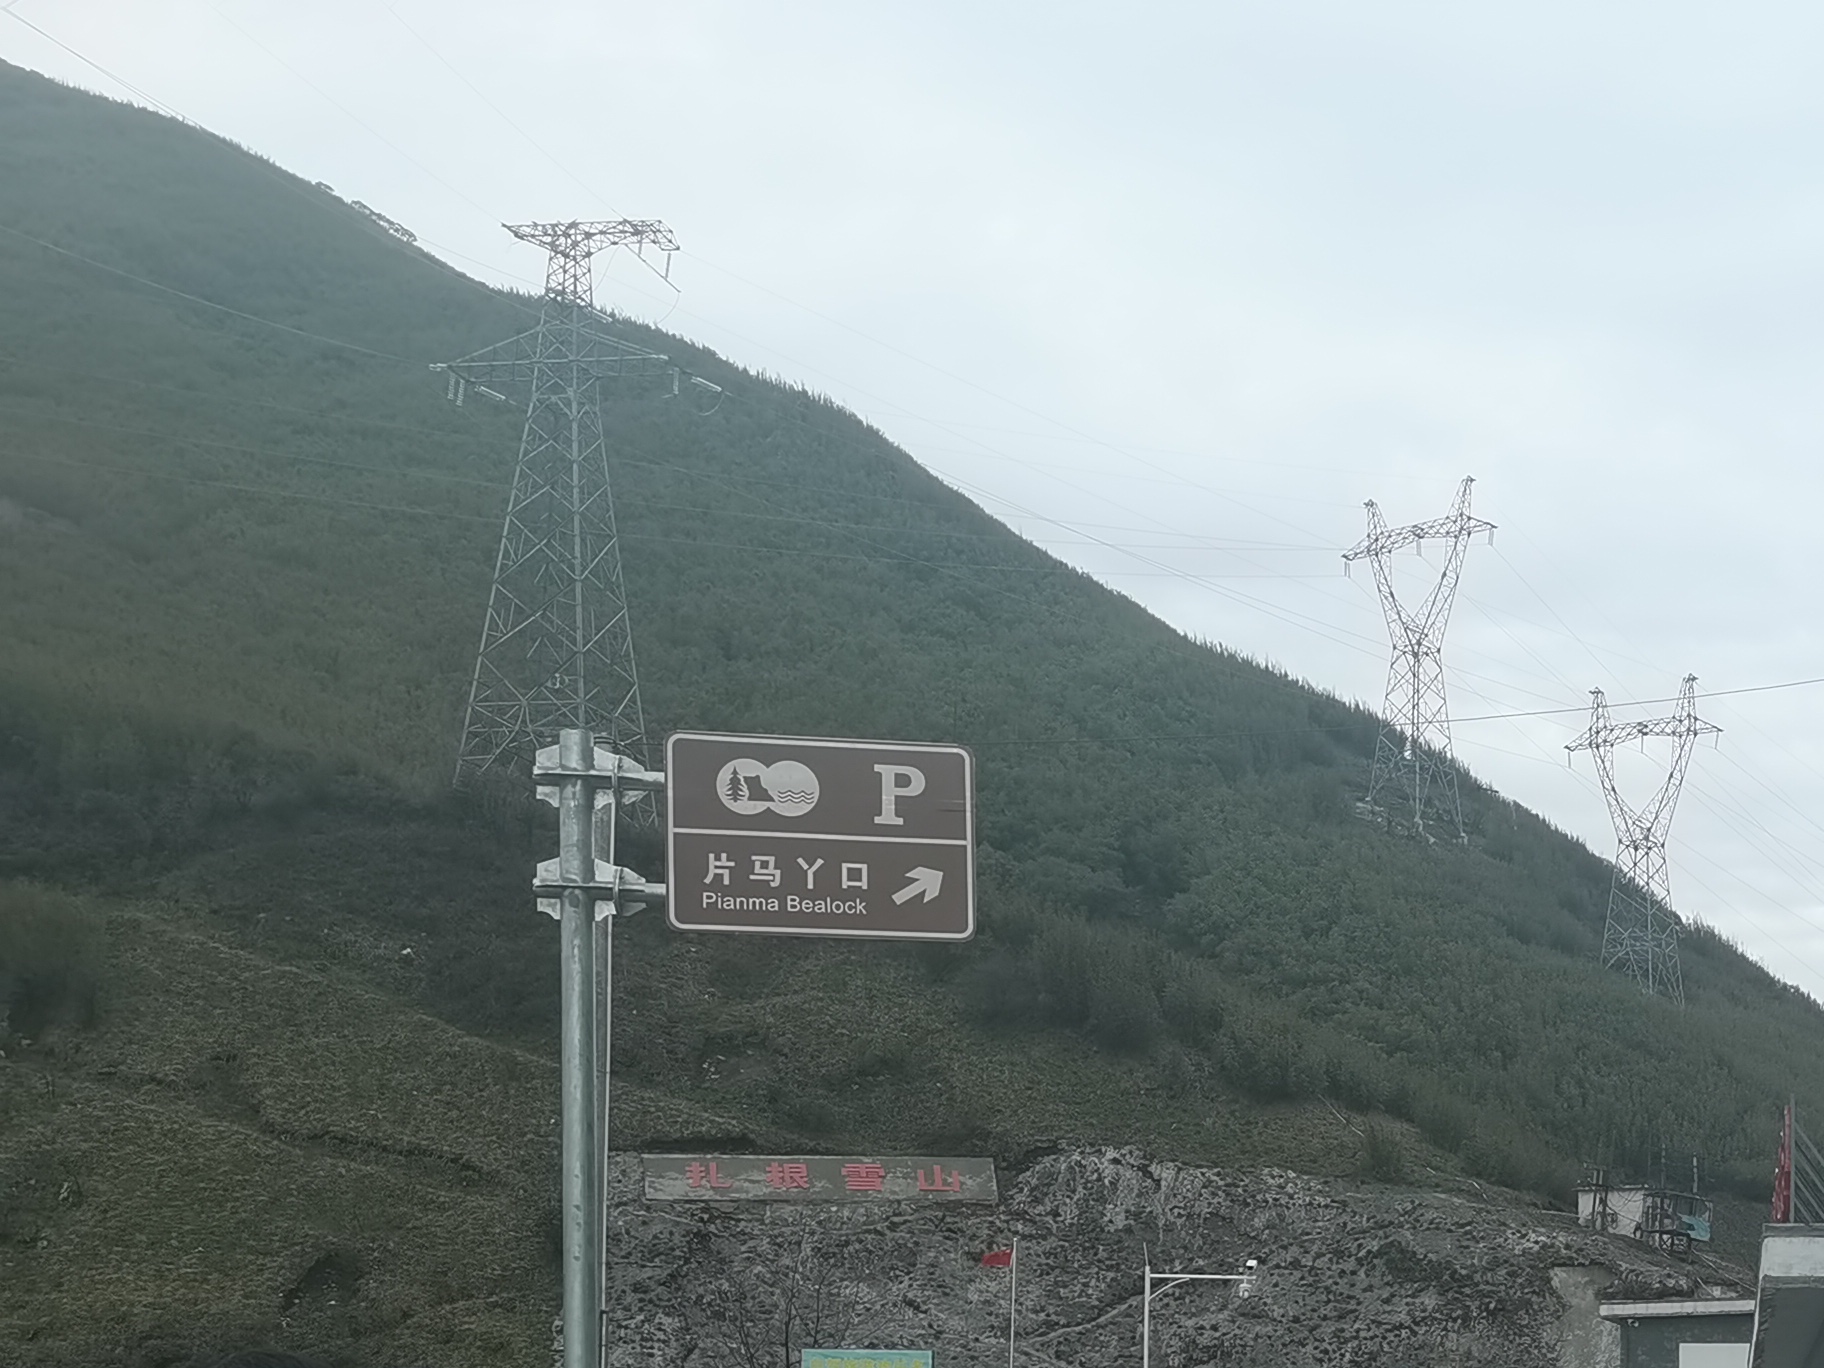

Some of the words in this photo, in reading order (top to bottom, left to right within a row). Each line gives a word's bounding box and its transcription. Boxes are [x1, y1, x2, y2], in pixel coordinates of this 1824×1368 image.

[702, 852, 869, 891] 片马丫口
[702, 892, 779, 914] Pianma
[786, 895, 868, 916] Bealock
[684, 1160, 961, 1193] 扎根雪山
